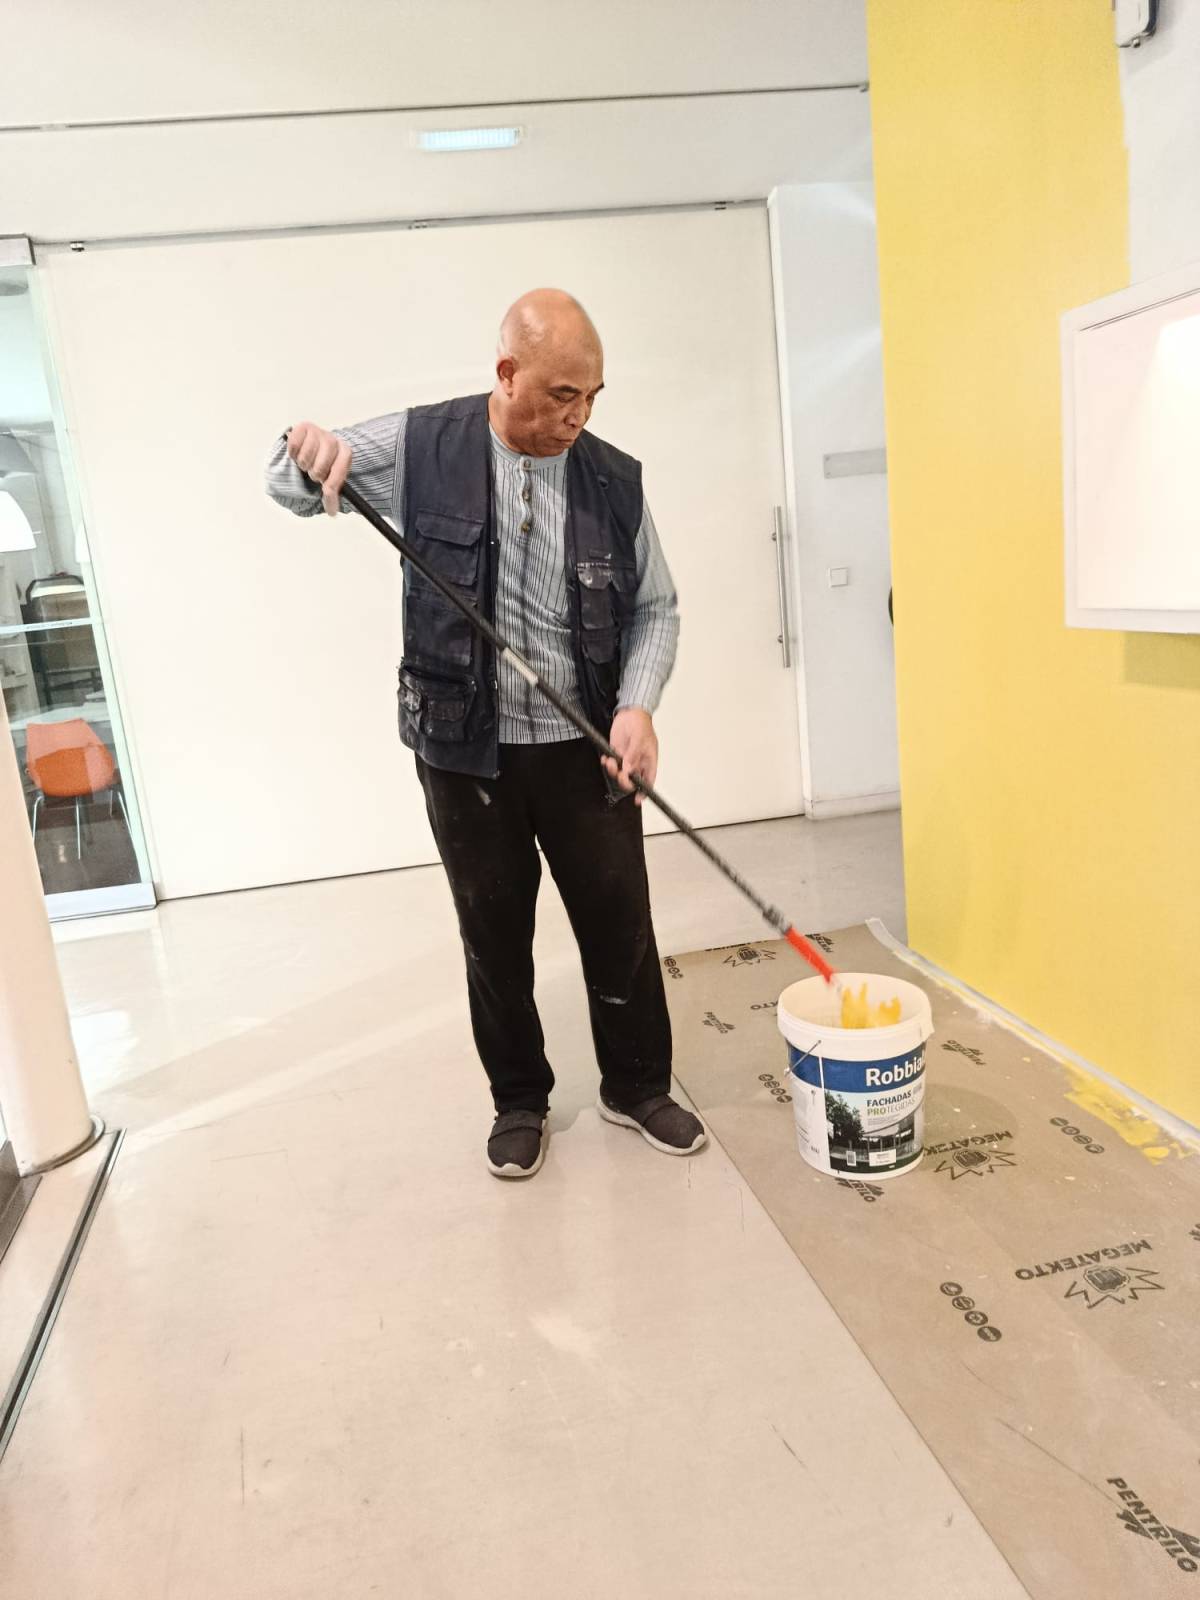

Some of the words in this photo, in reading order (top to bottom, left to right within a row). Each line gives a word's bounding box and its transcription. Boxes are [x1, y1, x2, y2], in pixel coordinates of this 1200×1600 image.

[866, 1089, 912, 1107] FACHADAS
[867, 1098, 916, 1116] PROTEGIDAS
[923, 1130, 1014, 1157] MEGATEK
[1015, 1239, 1152, 1280] MEGATEKTO
[1106, 1477, 1198, 1572] PENTRILO
